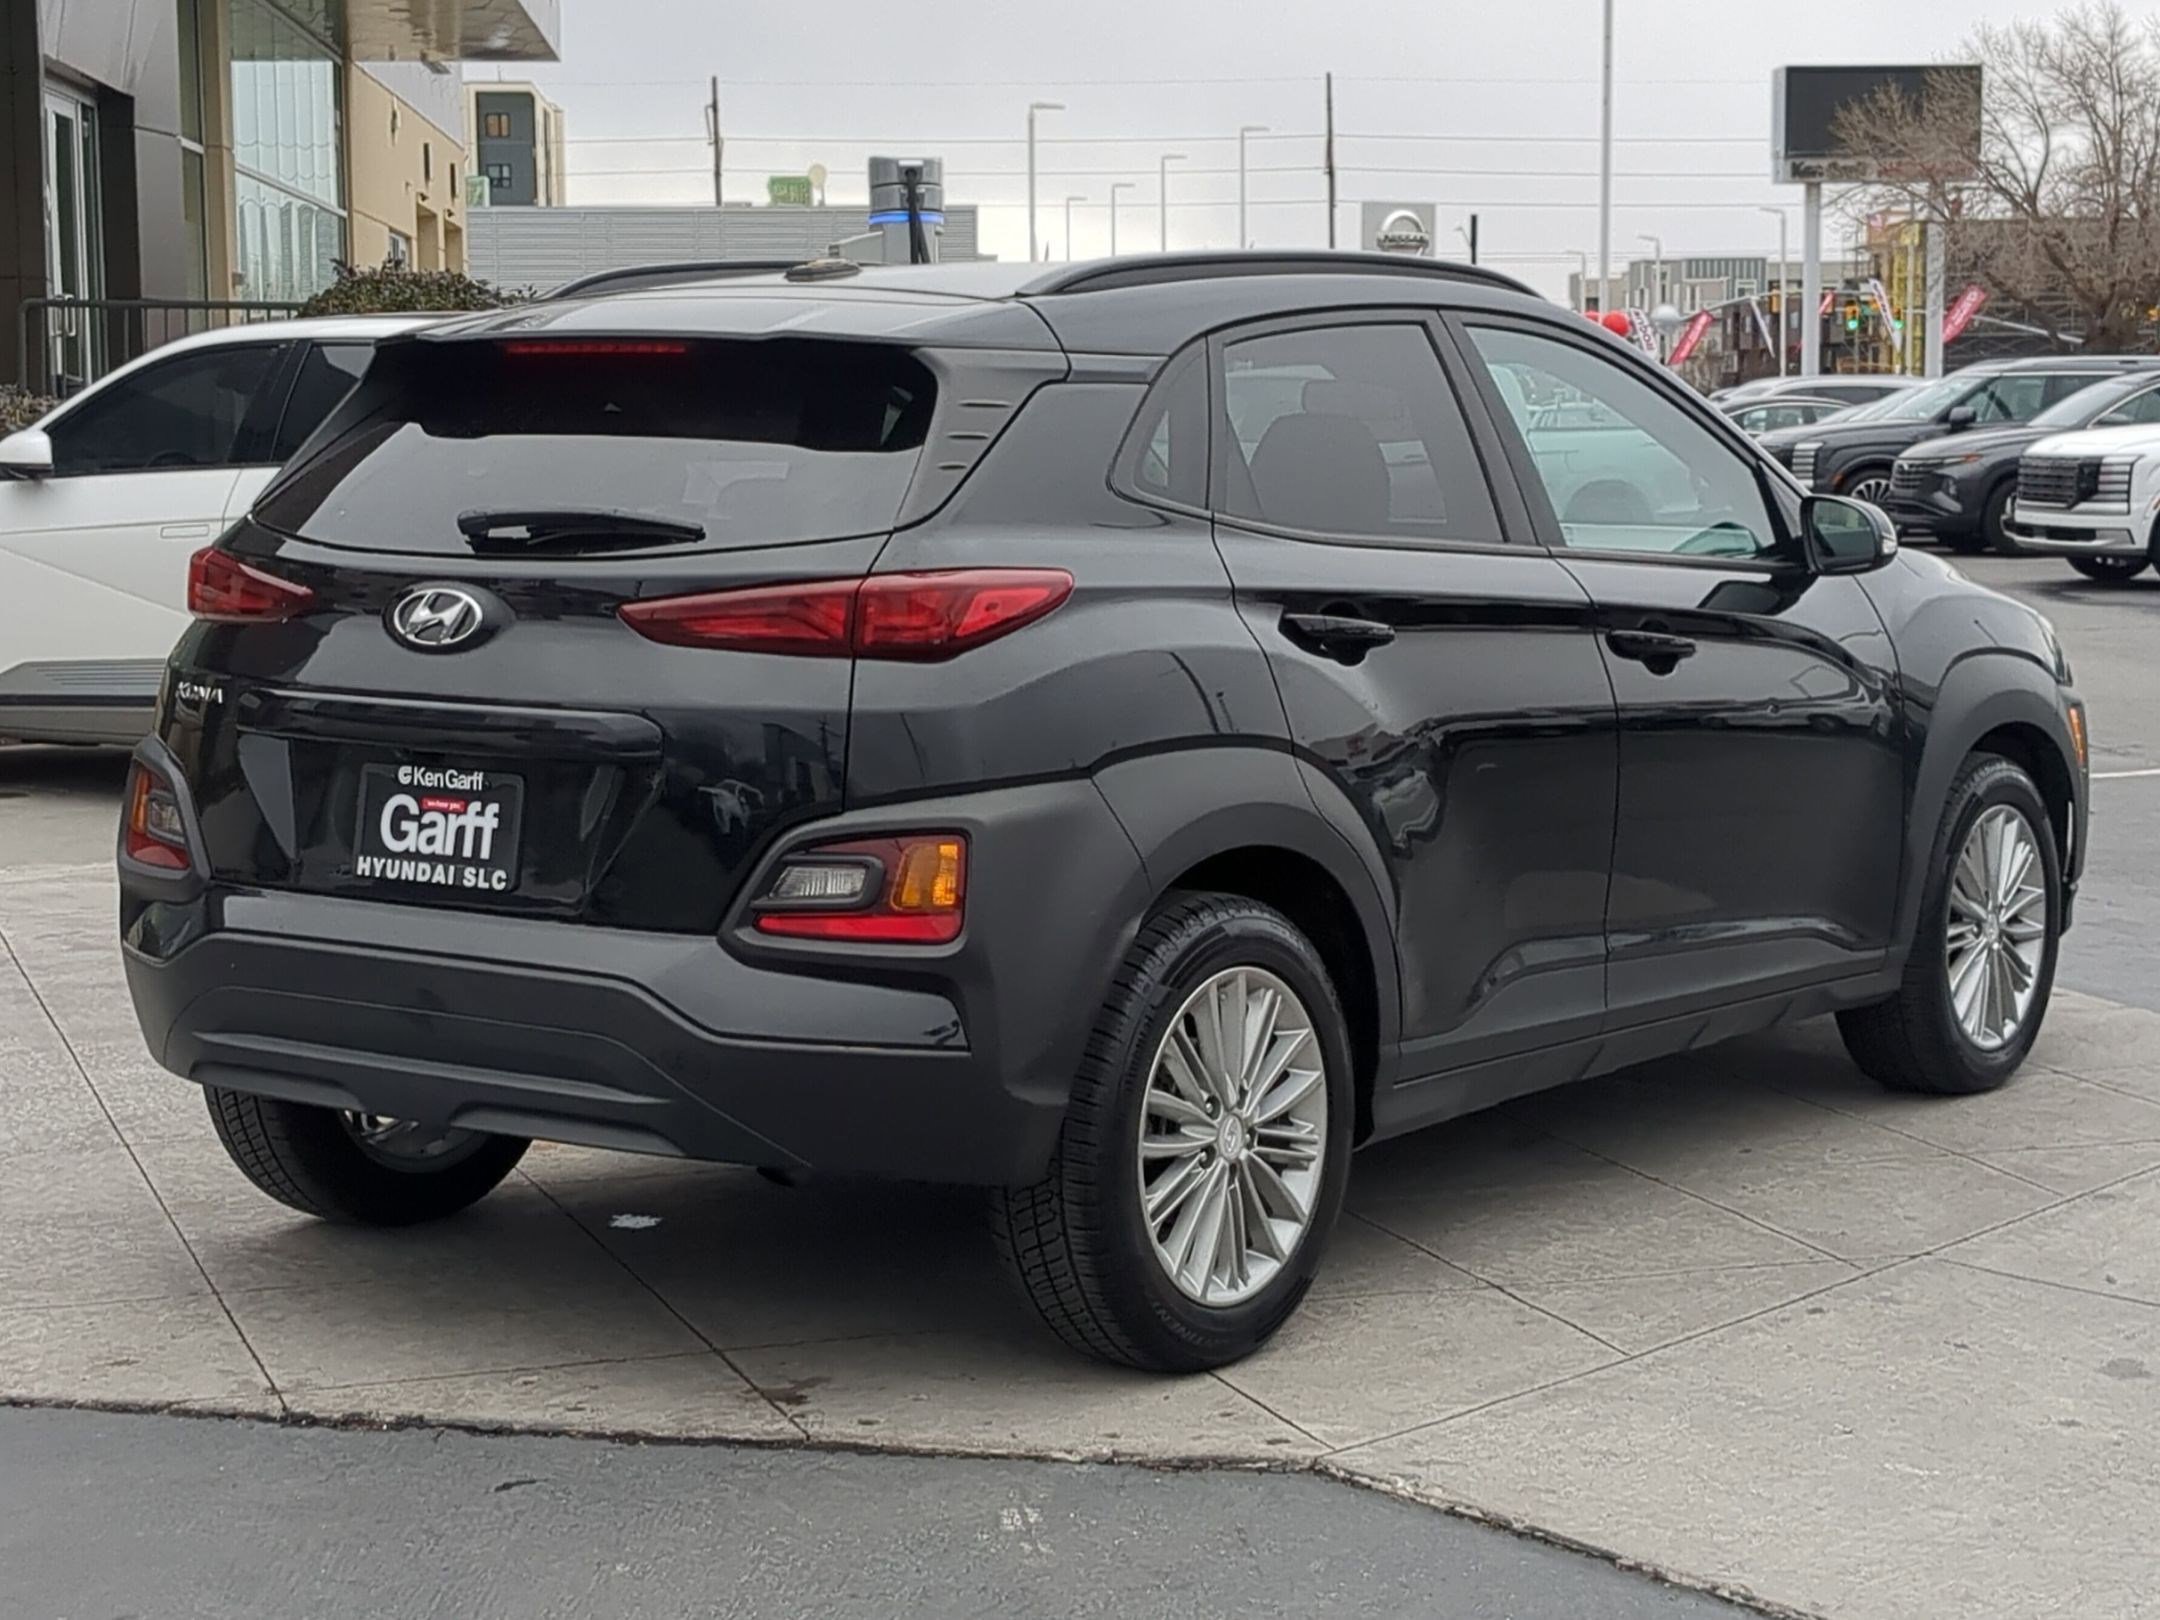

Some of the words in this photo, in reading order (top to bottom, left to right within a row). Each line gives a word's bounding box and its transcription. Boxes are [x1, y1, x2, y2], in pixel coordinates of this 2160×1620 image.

[413, 766, 444, 788] Ken
[445, 769, 484, 791] Garff
[380, 793, 500, 860] Garff
[356, 856, 456, 886] HYUNDAI
[462, 867, 507, 891] SLC
